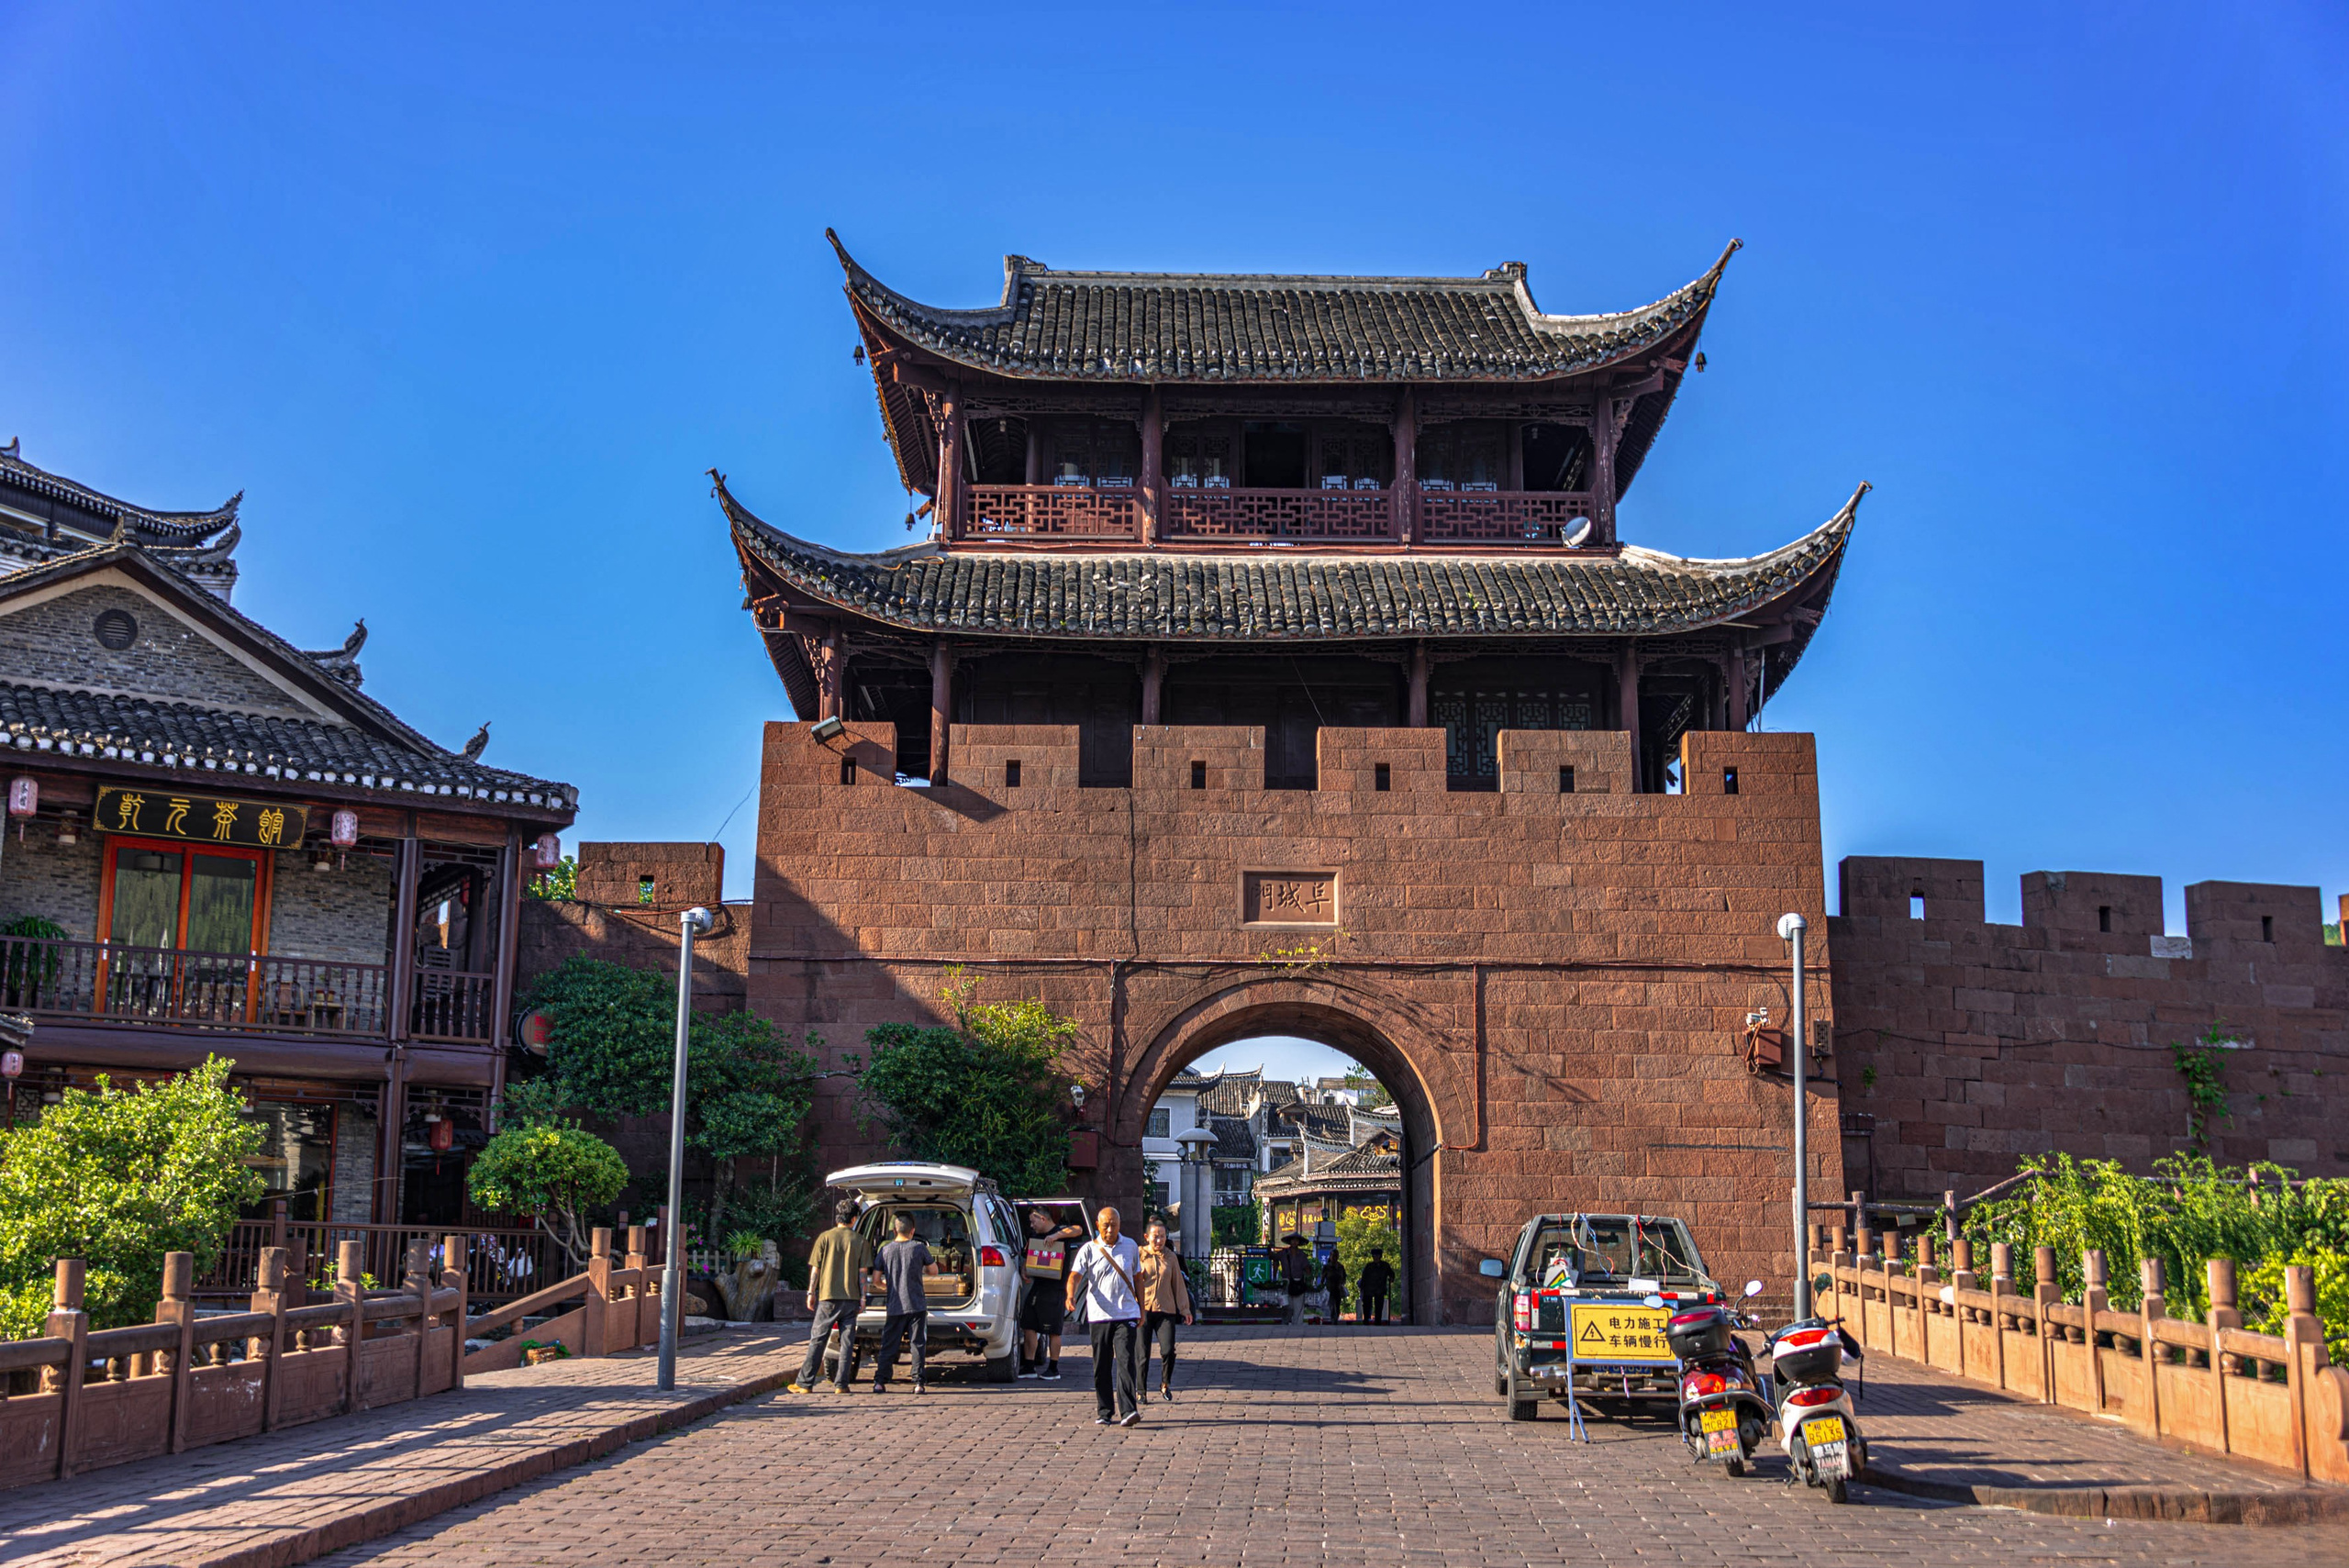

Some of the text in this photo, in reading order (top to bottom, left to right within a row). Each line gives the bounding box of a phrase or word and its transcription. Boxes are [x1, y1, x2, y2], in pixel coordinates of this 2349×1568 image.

[1609, 1316, 1664, 1330] 电力施工
[1609, 1334, 1667, 1349] 车辆慢行
[1809, 1428, 1842, 1444] R5135
